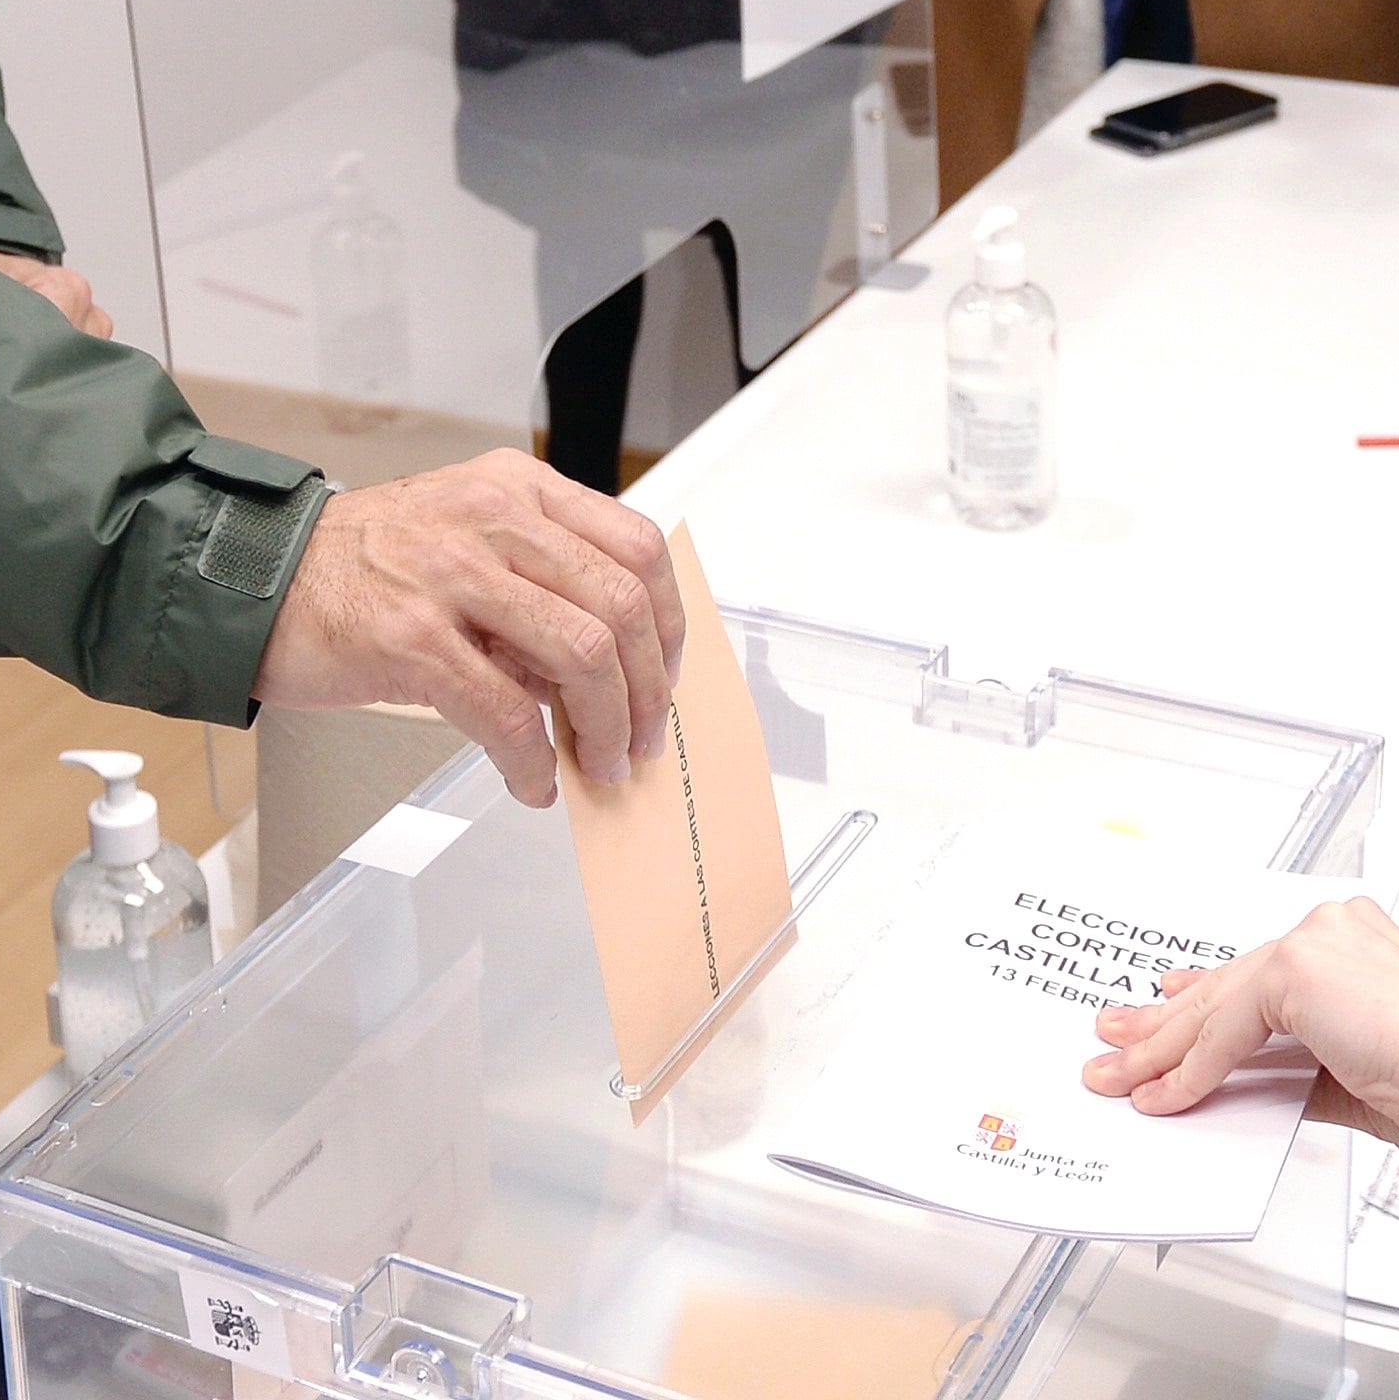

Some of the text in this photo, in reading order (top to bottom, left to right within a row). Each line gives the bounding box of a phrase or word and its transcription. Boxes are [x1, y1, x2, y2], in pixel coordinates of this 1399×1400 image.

[670, 701, 720, 1000] LECCIONES A LAS CORTES DE CASTILL
[1014, 893, 1237, 961] ELECCIONES
[1031, 923, 1174, 974] CORTES
[965, 933, 1163, 998] CASTILLA Y
[990, 965, 1016, 981] 13
[956, 1144, 1103, 1182] Castilla y León
[1019, 1148, 1109, 1171] Junta de
